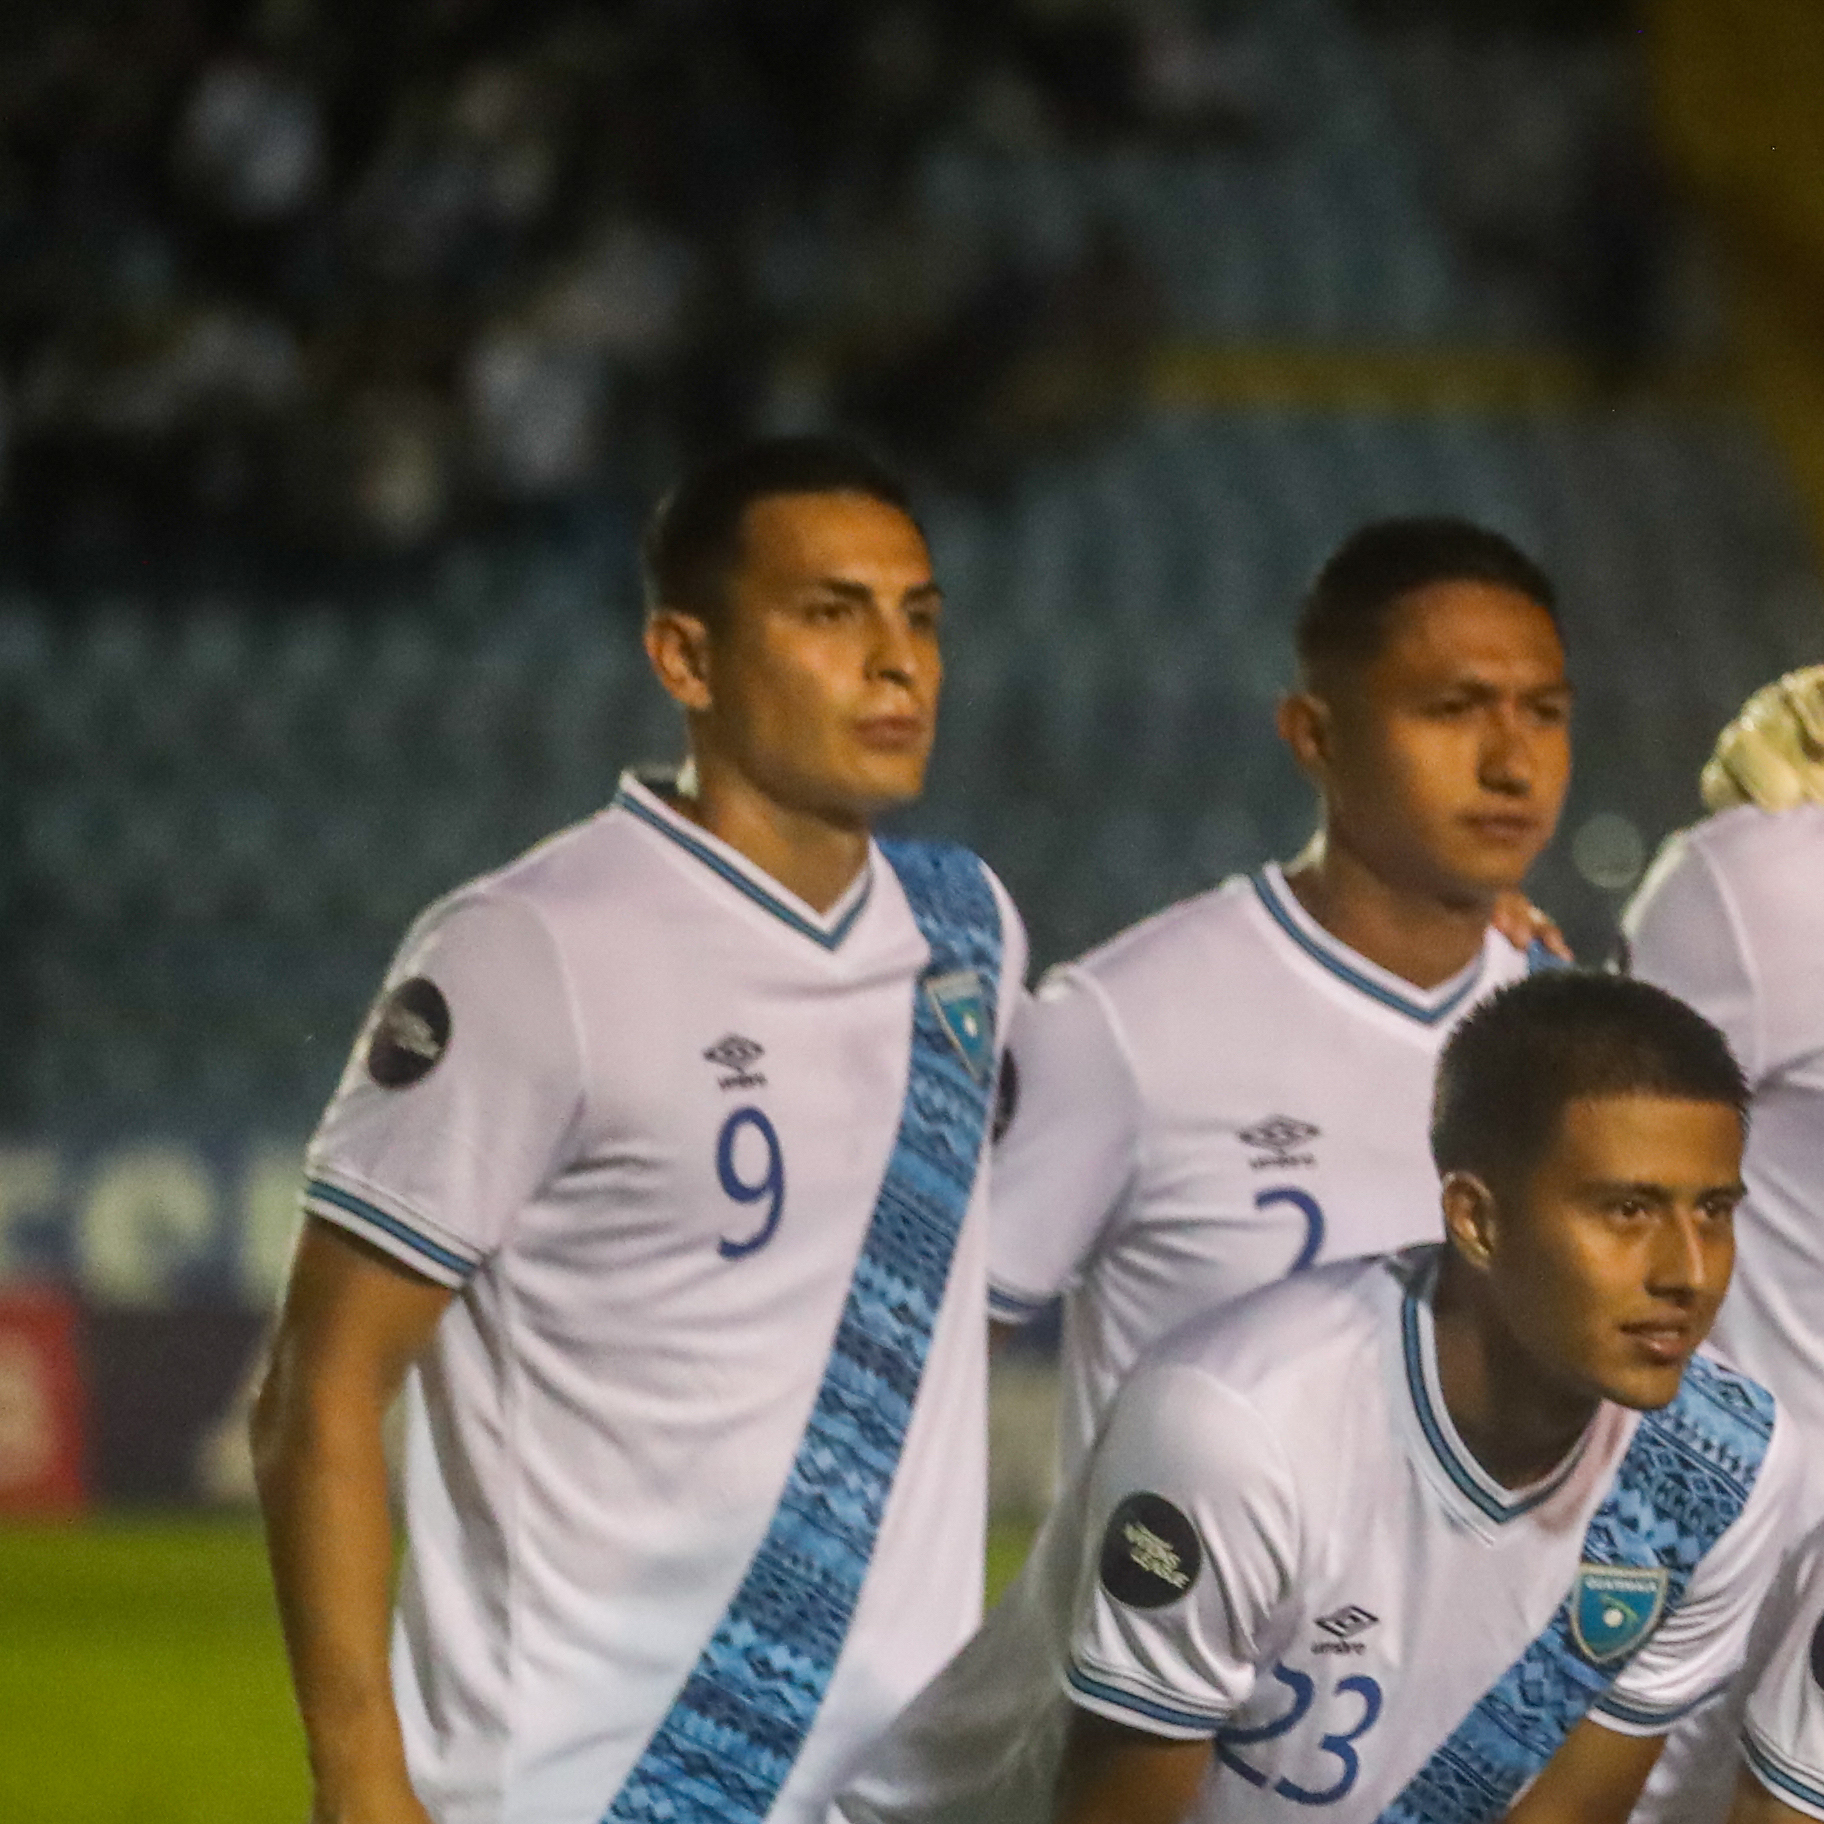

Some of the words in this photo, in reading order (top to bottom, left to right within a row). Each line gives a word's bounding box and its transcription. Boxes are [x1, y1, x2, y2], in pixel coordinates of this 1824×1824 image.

[716, 1107, 784, 1259] 9
[1255, 1187, 1325, 1276] 2
[1216, 1662, 1382, 1805] 23
